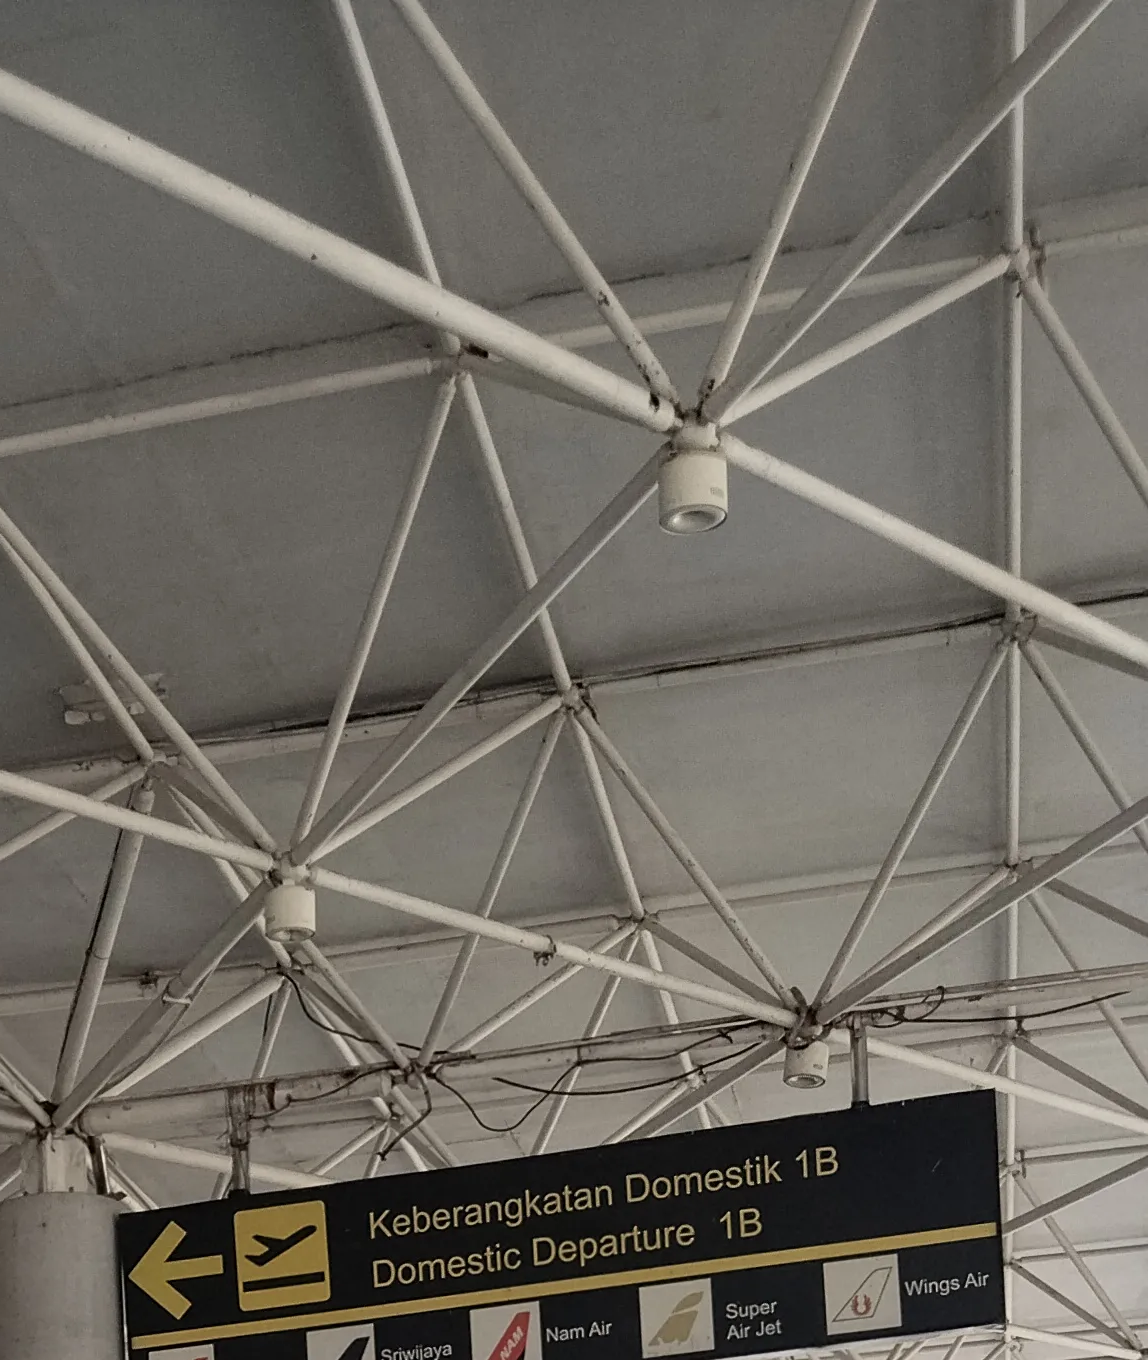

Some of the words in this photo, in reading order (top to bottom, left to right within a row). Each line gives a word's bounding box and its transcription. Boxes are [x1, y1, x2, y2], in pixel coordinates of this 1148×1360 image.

[368, 1184, 613, 1240] Keberangkatan
[625, 1154, 783, 1204] Domestik
[795, 1145, 840, 1179] 1B
[371, 1243, 522, 1289] Domestic
[532, 1222, 696, 1267] Departure
[719, 1207, 763, 1240] 1B
[904, 1277, 961, 1297] Wings
[963, 1271, 990, 1288] Air
[725, 1300, 778, 1320] Super
[545, 1323, 585, 1343] Nam
[588, 1320, 612, 1337] Air
[726, 1323, 751, 1340] Air
[755, 1318, 782, 1337] Jet
